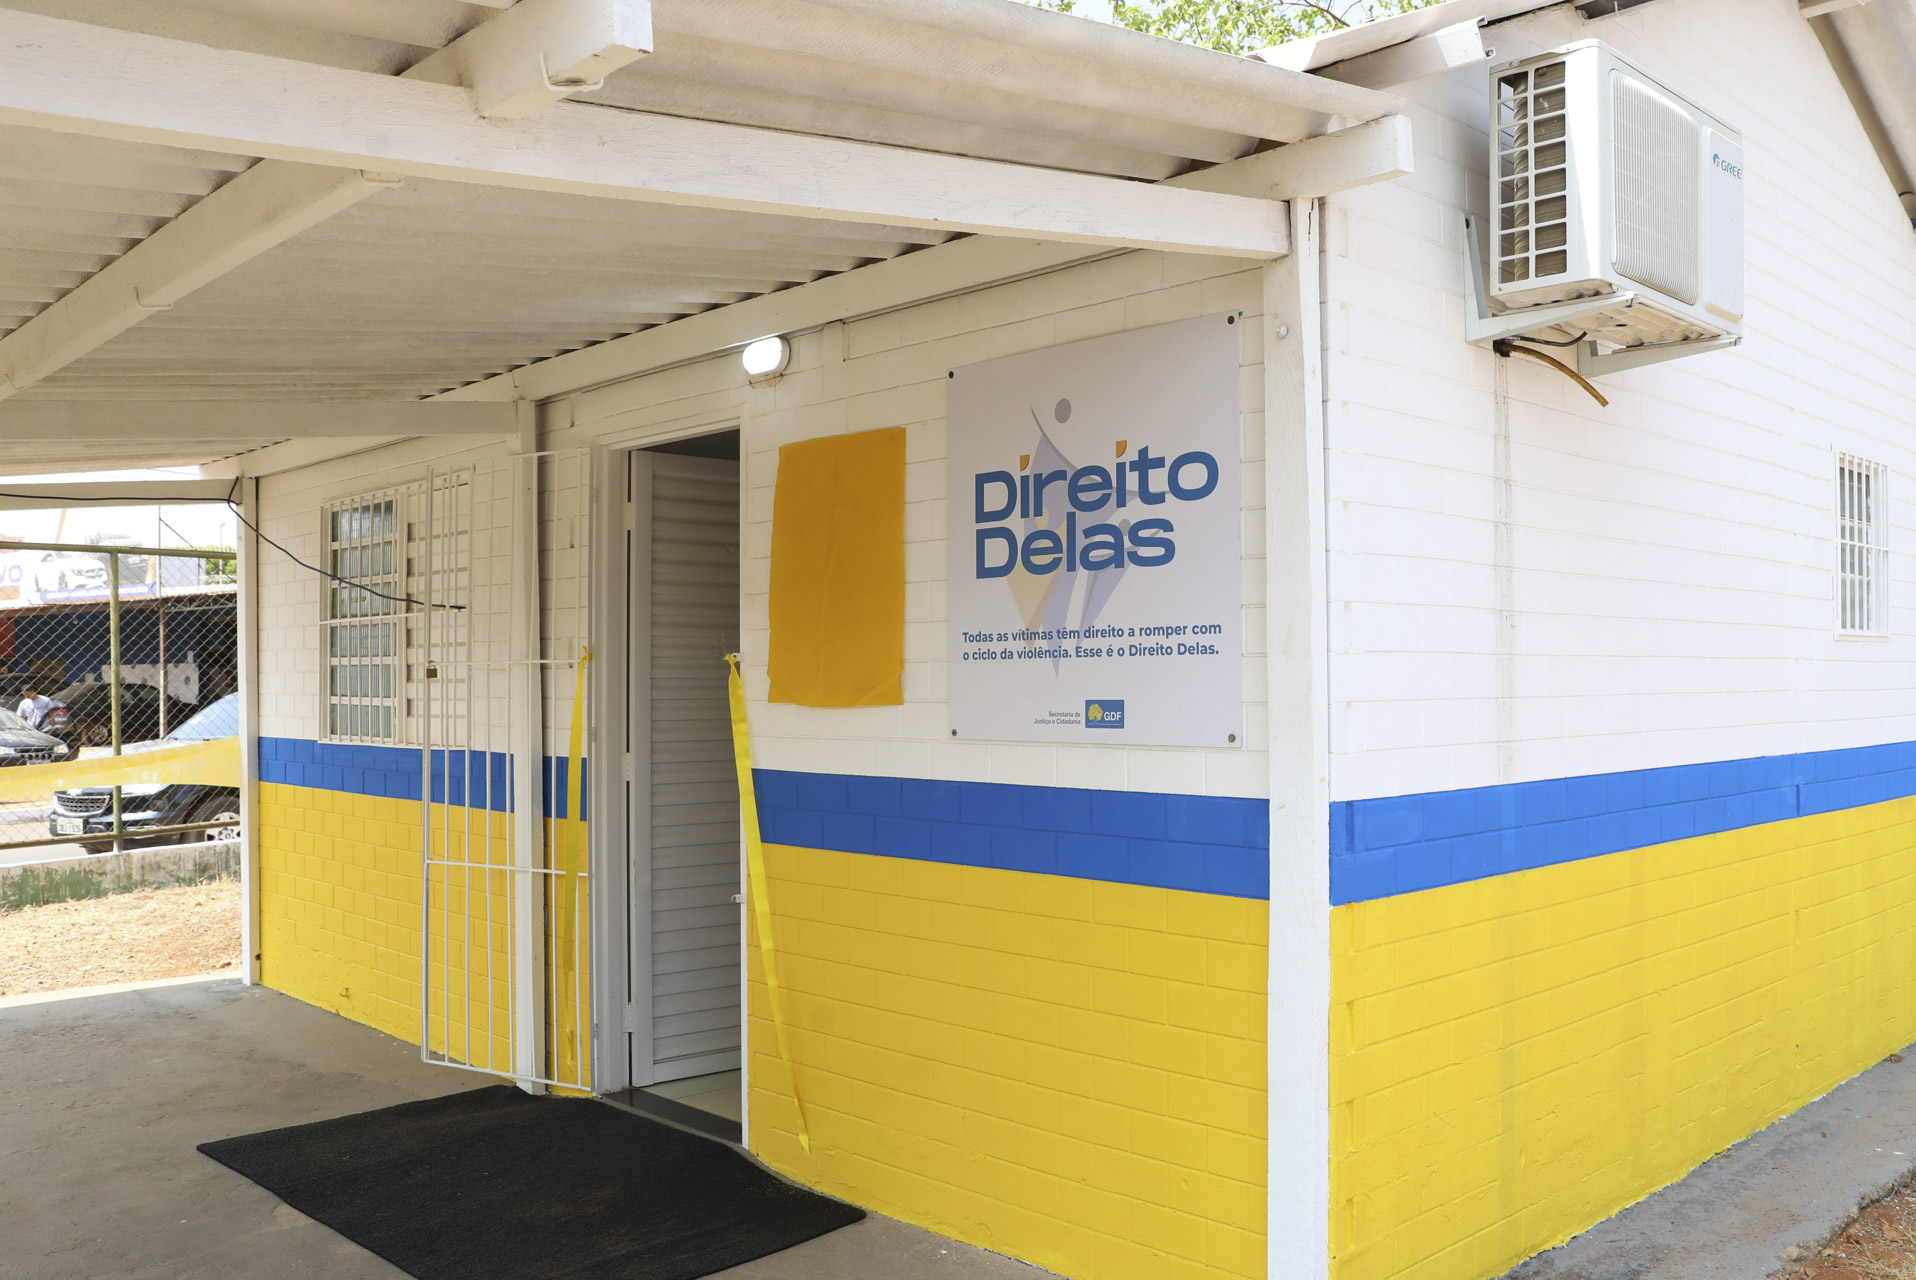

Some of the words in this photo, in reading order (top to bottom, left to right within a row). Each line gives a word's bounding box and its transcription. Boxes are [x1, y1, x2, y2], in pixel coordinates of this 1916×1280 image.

[1720, 159, 1742, 180] GREE
[975, 439, 1219, 524] Direito
[976, 511, 1176, 580] Delas
[962, 630, 993, 643] Todas
[996, 632, 1009, 642] as
[1011, 627, 1053, 641] vítimas
[1056, 626, 1080, 640] têm
[1083, 624, 1124, 639] direito
[1127, 627, 1135, 637] a
[1139, 625, 1188, 639] romper
[1191, 623, 1222, 635] com
[962, 651, 970, 661] o
[972, 647, 997, 661] ciclo
[1000, 647, 1014, 660] da
[1016, 645, 1072, 660] violência.
[1075, 645, 1103, 658] Esse
[1106, 643, 1114, 657] é
[1117, 646, 1125, 657] o
[1128, 641, 1173, 657] Direito
[1177, 641, 1219, 656] Delas.
[1033, 718, 1051, 726] Justiça
[1048, 710, 1073, 718] Secretaria
[1074, 710, 1081, 718] de
[1103, 711, 1122, 721] GDF
